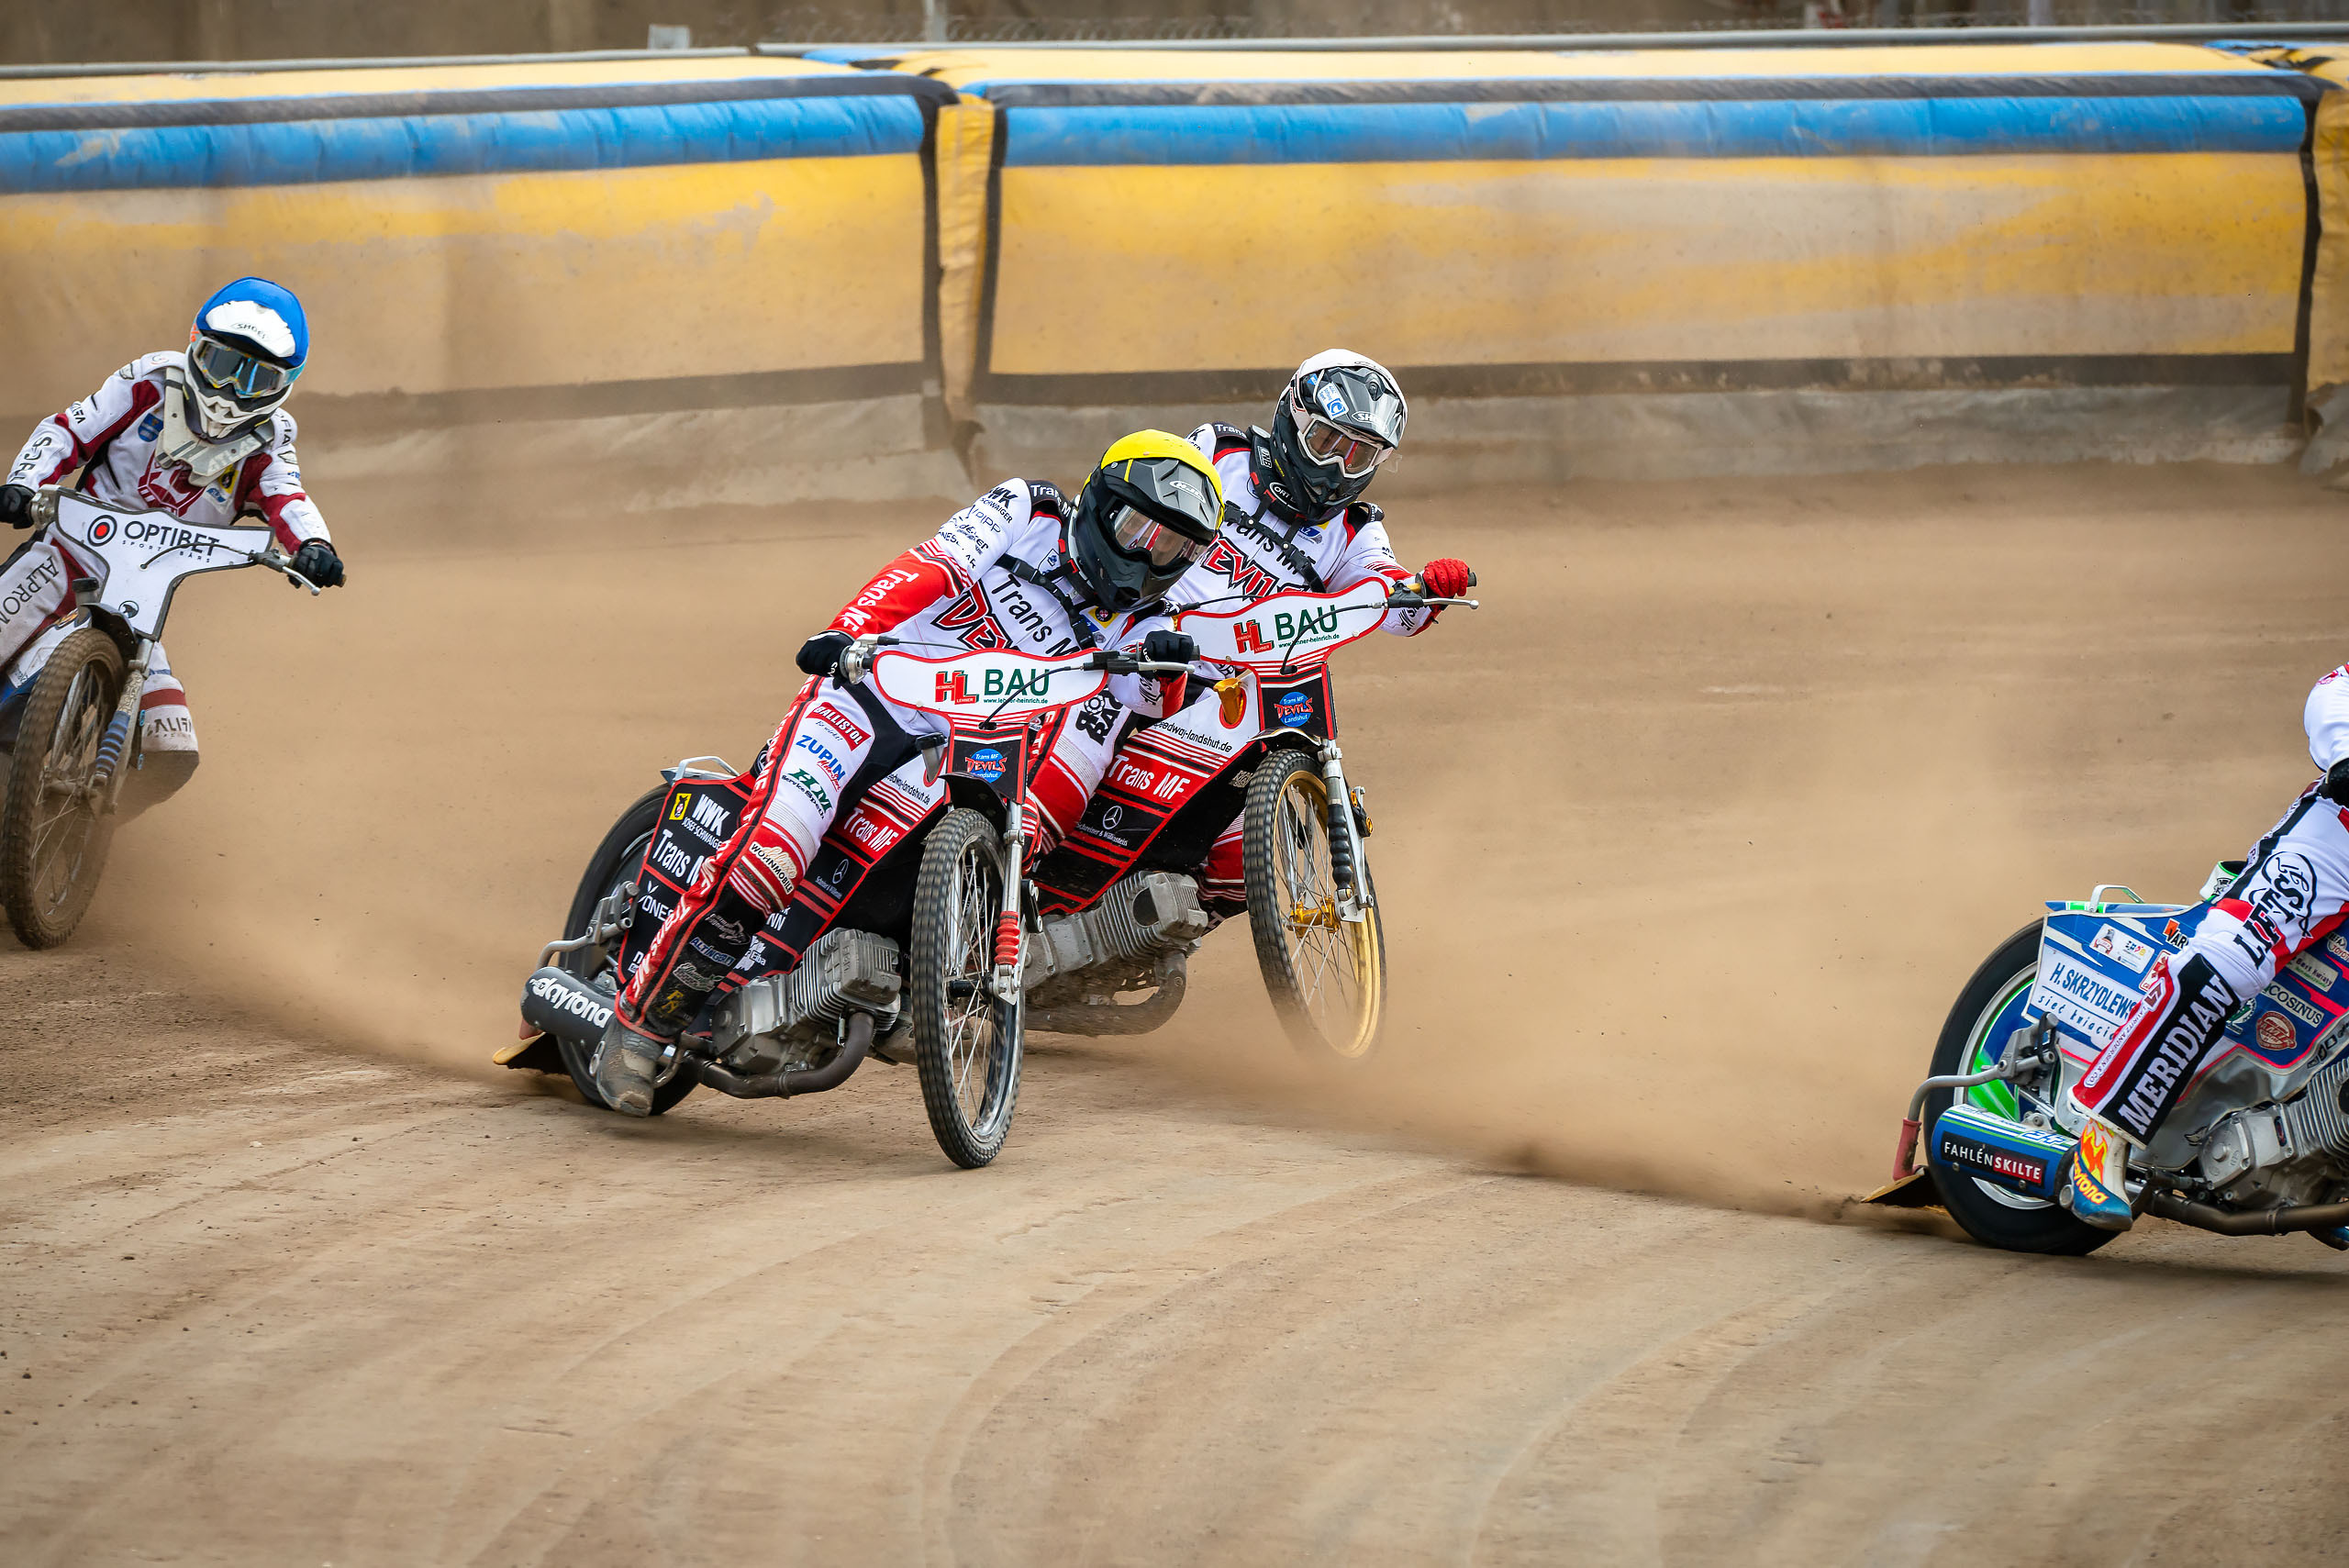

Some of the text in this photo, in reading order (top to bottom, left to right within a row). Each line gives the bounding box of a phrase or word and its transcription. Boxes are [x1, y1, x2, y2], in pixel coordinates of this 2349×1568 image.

[122, 539, 161, 551] SPORT
[124, 520, 220, 557] OPTIBET
[857, 569, 919, 606] Trans
[992, 573, 1052, 642] Trans
[1274, 605, 1339, 641] BAU
[984, 669, 1051, 696] BAU
[814, 706, 863, 745] BALLISTOL
[1274, 697, 1314, 719] DEVILS
[1285, 714, 1308, 724] Landshut
[796, 734, 846, 782] ZUPIN
[964, 756, 1008, 773] DEVILS
[1108, 754, 1155, 791] Trans
[1152, 772, 1191, 800] MF
[692, 794, 731, 837] WWK
[844, 807, 899, 852] Trans MF
[652, 828, 691, 878] Trans
[695, 825, 722, 851] SCHWAIGE
[751, 843, 794, 893] WOHNMOBILE
[2166, 929, 2188, 949] VAR
[532, 977, 615, 1029] daytona
[2269, 984, 2322, 1025] COSINUS
[2117, 974, 2234, 1136] MERIDIAN
